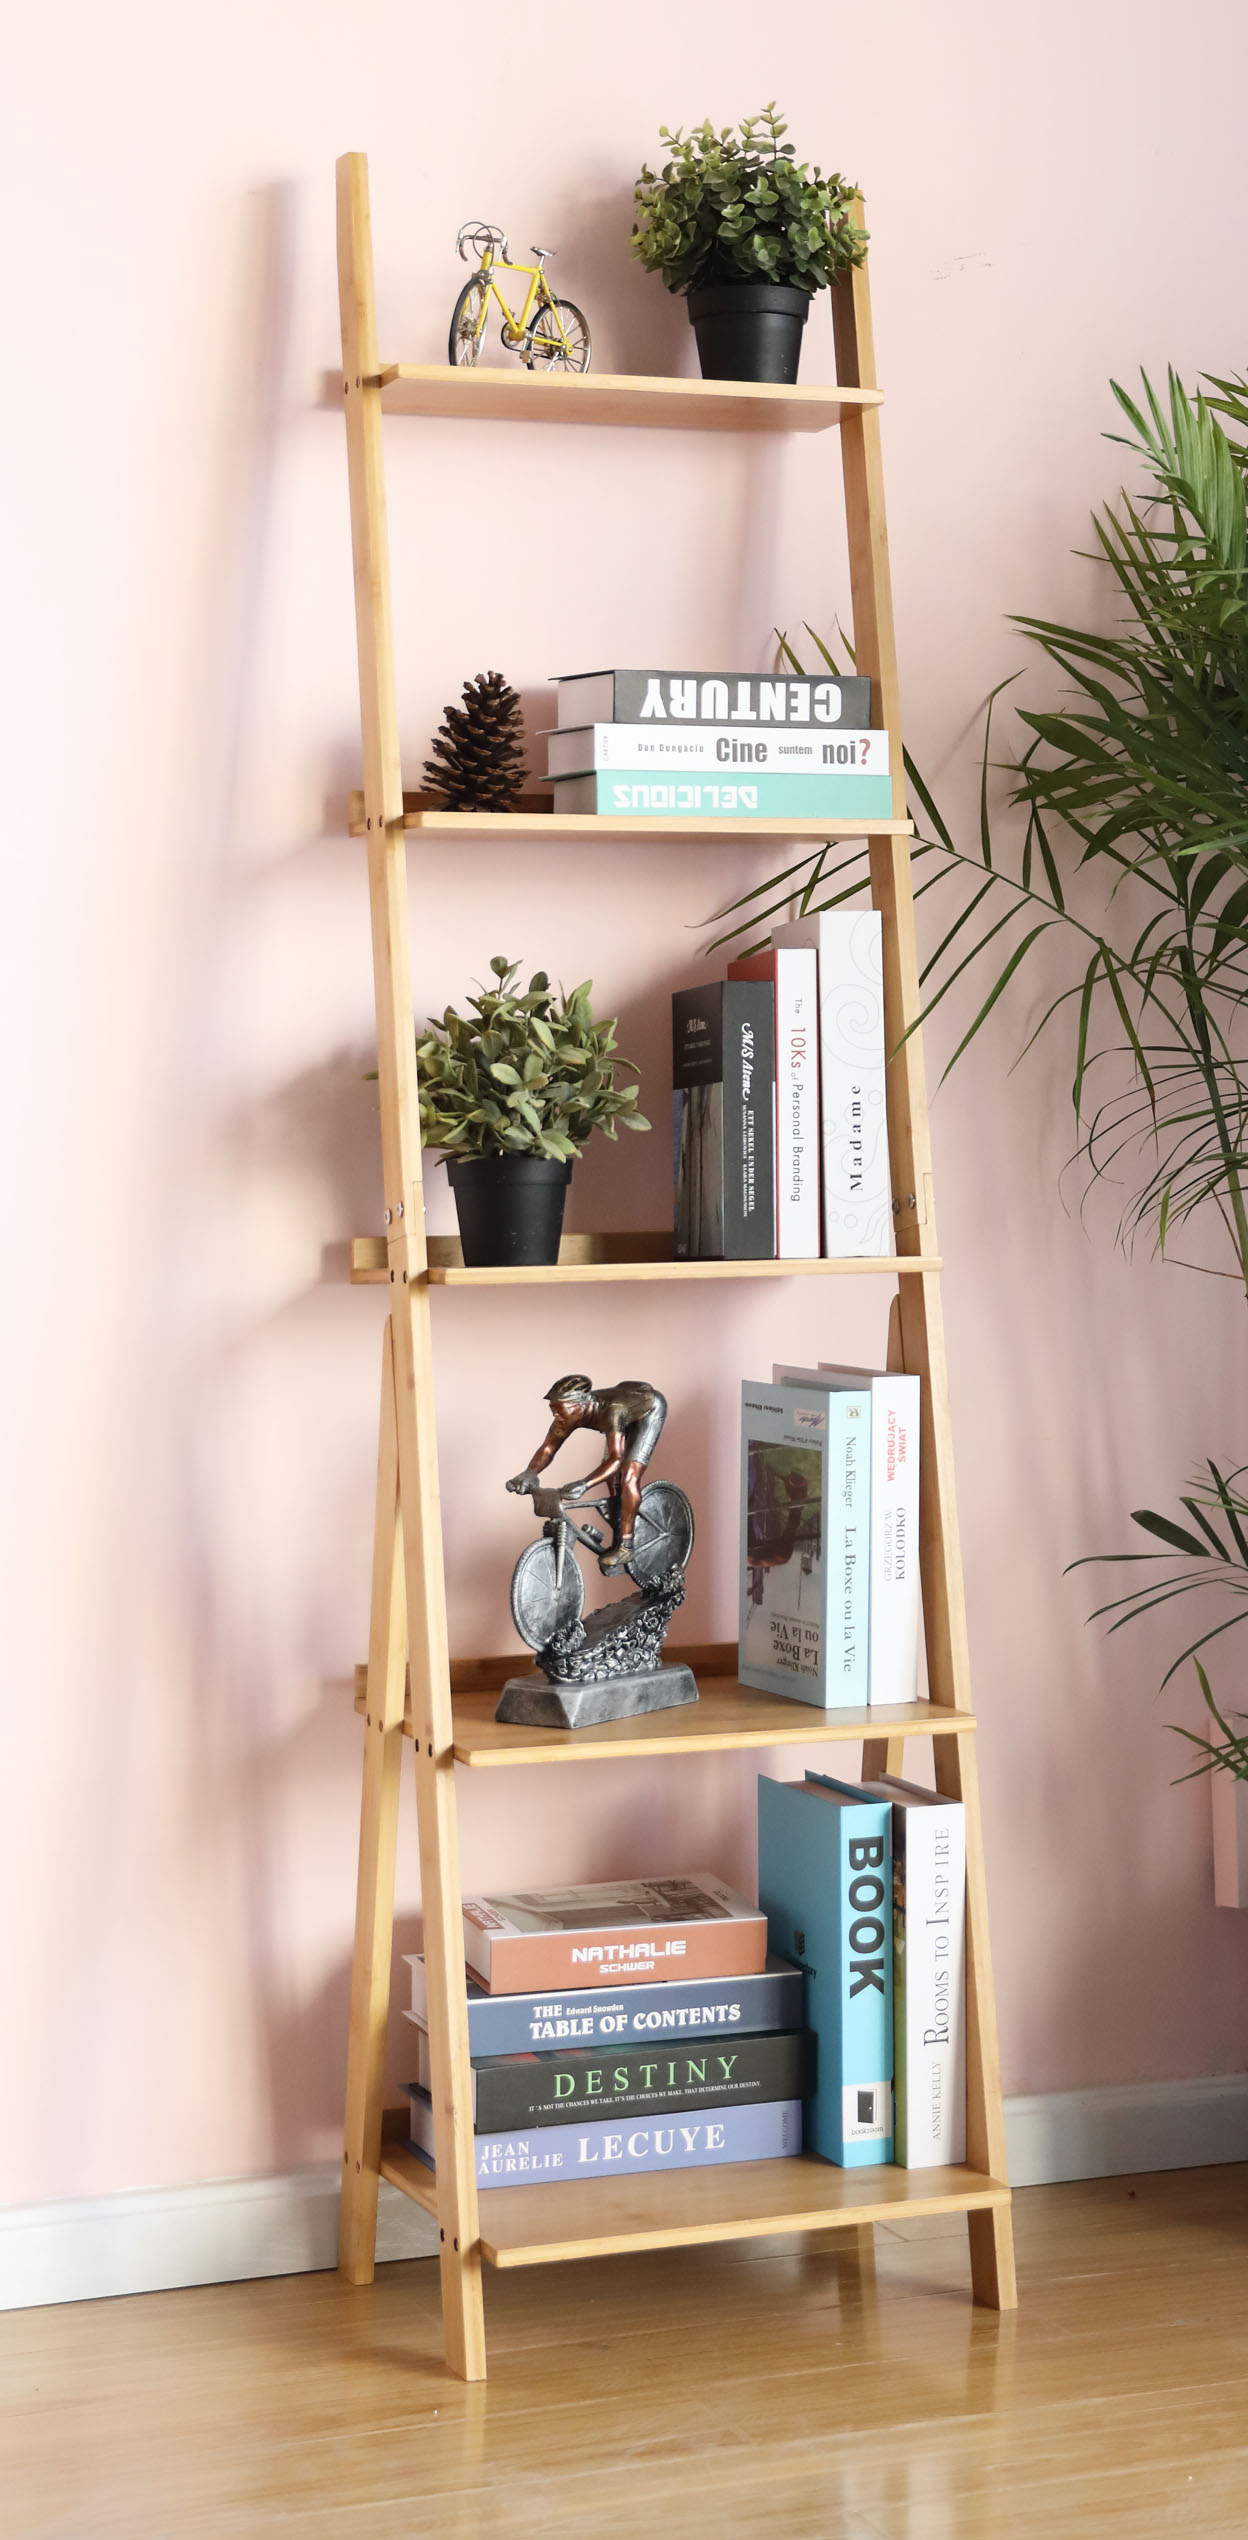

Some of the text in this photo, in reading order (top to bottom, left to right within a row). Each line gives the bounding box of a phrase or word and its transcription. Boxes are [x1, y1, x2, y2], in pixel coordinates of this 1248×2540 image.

[640, 678, 842, 723] CENTURY
[637, 743, 655, 752] Dan
[715, 737, 768, 763] Cine
[778, 744, 813, 755] suntem
[822, 738, 871, 765] noi?
[612, 784, 759, 809] DELICIOUS
[742, 1059, 754, 1101] Atene
[790, 998, 807, 1202] The 10Ks of Personal Branding
[747, 1110, 755, 1125] ETT
[849, 1085, 863, 1191] Madame
[842, 1436, 857, 1508] Noah Klieger
[883, 1522, 893, 1582] GRZEGORZ
[843, 1527, 857, 1672] La Boxe ou la Vie
[769, 1621, 819, 1643] ou la Vie
[772, 1640, 819, 1666] La Boxe
[776, 1657, 819, 1678] Noah Klieger
[848, 1835, 885, 2000] BOOK
[571, 1940, 687, 1963] NATHALIE
[934, 1934, 949, 1962] TO
[599, 1960, 656, 1974] SCHWER
[529, 2003, 741, 2040] TABLE OF CONTENTS
[533, 2003, 624, 2019] THE Edward Snowden
[553, 2054, 739, 2099] DESTINY
[543, 2103, 554, 2111] NOT
[684, 2087, 698, 2095] THAT
[698, 2084, 727, 2093] DETERMINE
[931, 2061, 942, 2141] ANNIE KELLY
[577, 2123, 727, 2164] LECUYE
[851, 2125, 884, 2136] bookroom
[478, 2153, 565, 2175] AURELIE
[481, 2140, 531, 2161] JEAN
